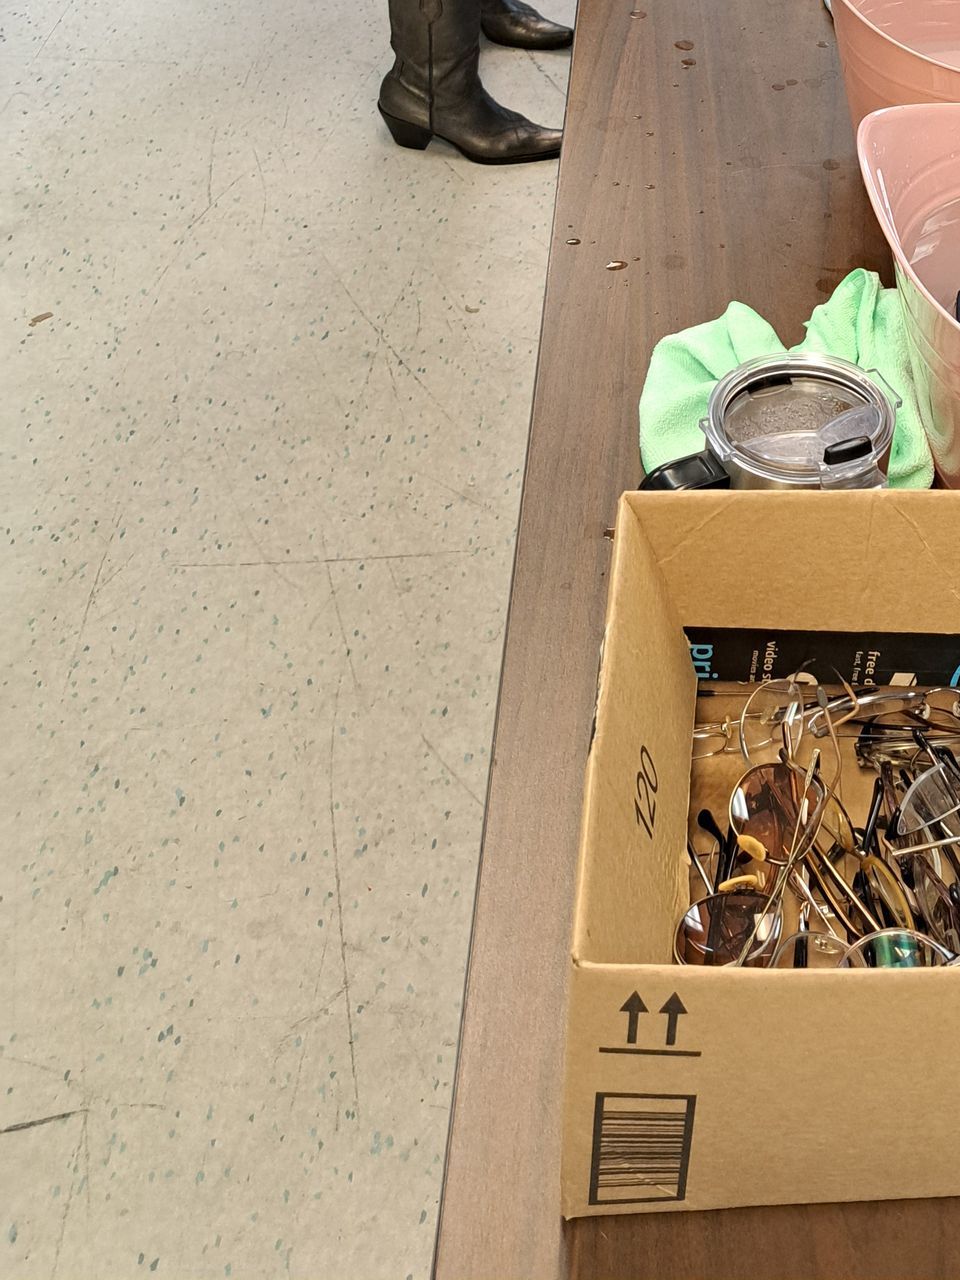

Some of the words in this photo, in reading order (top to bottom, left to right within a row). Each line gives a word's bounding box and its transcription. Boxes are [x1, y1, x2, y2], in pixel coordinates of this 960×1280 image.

[751, 650, 759, 674] movies
[763, 641, 778, 671] video
[866, 650, 881, 672] free
[634, 745, 658, 840] 120
